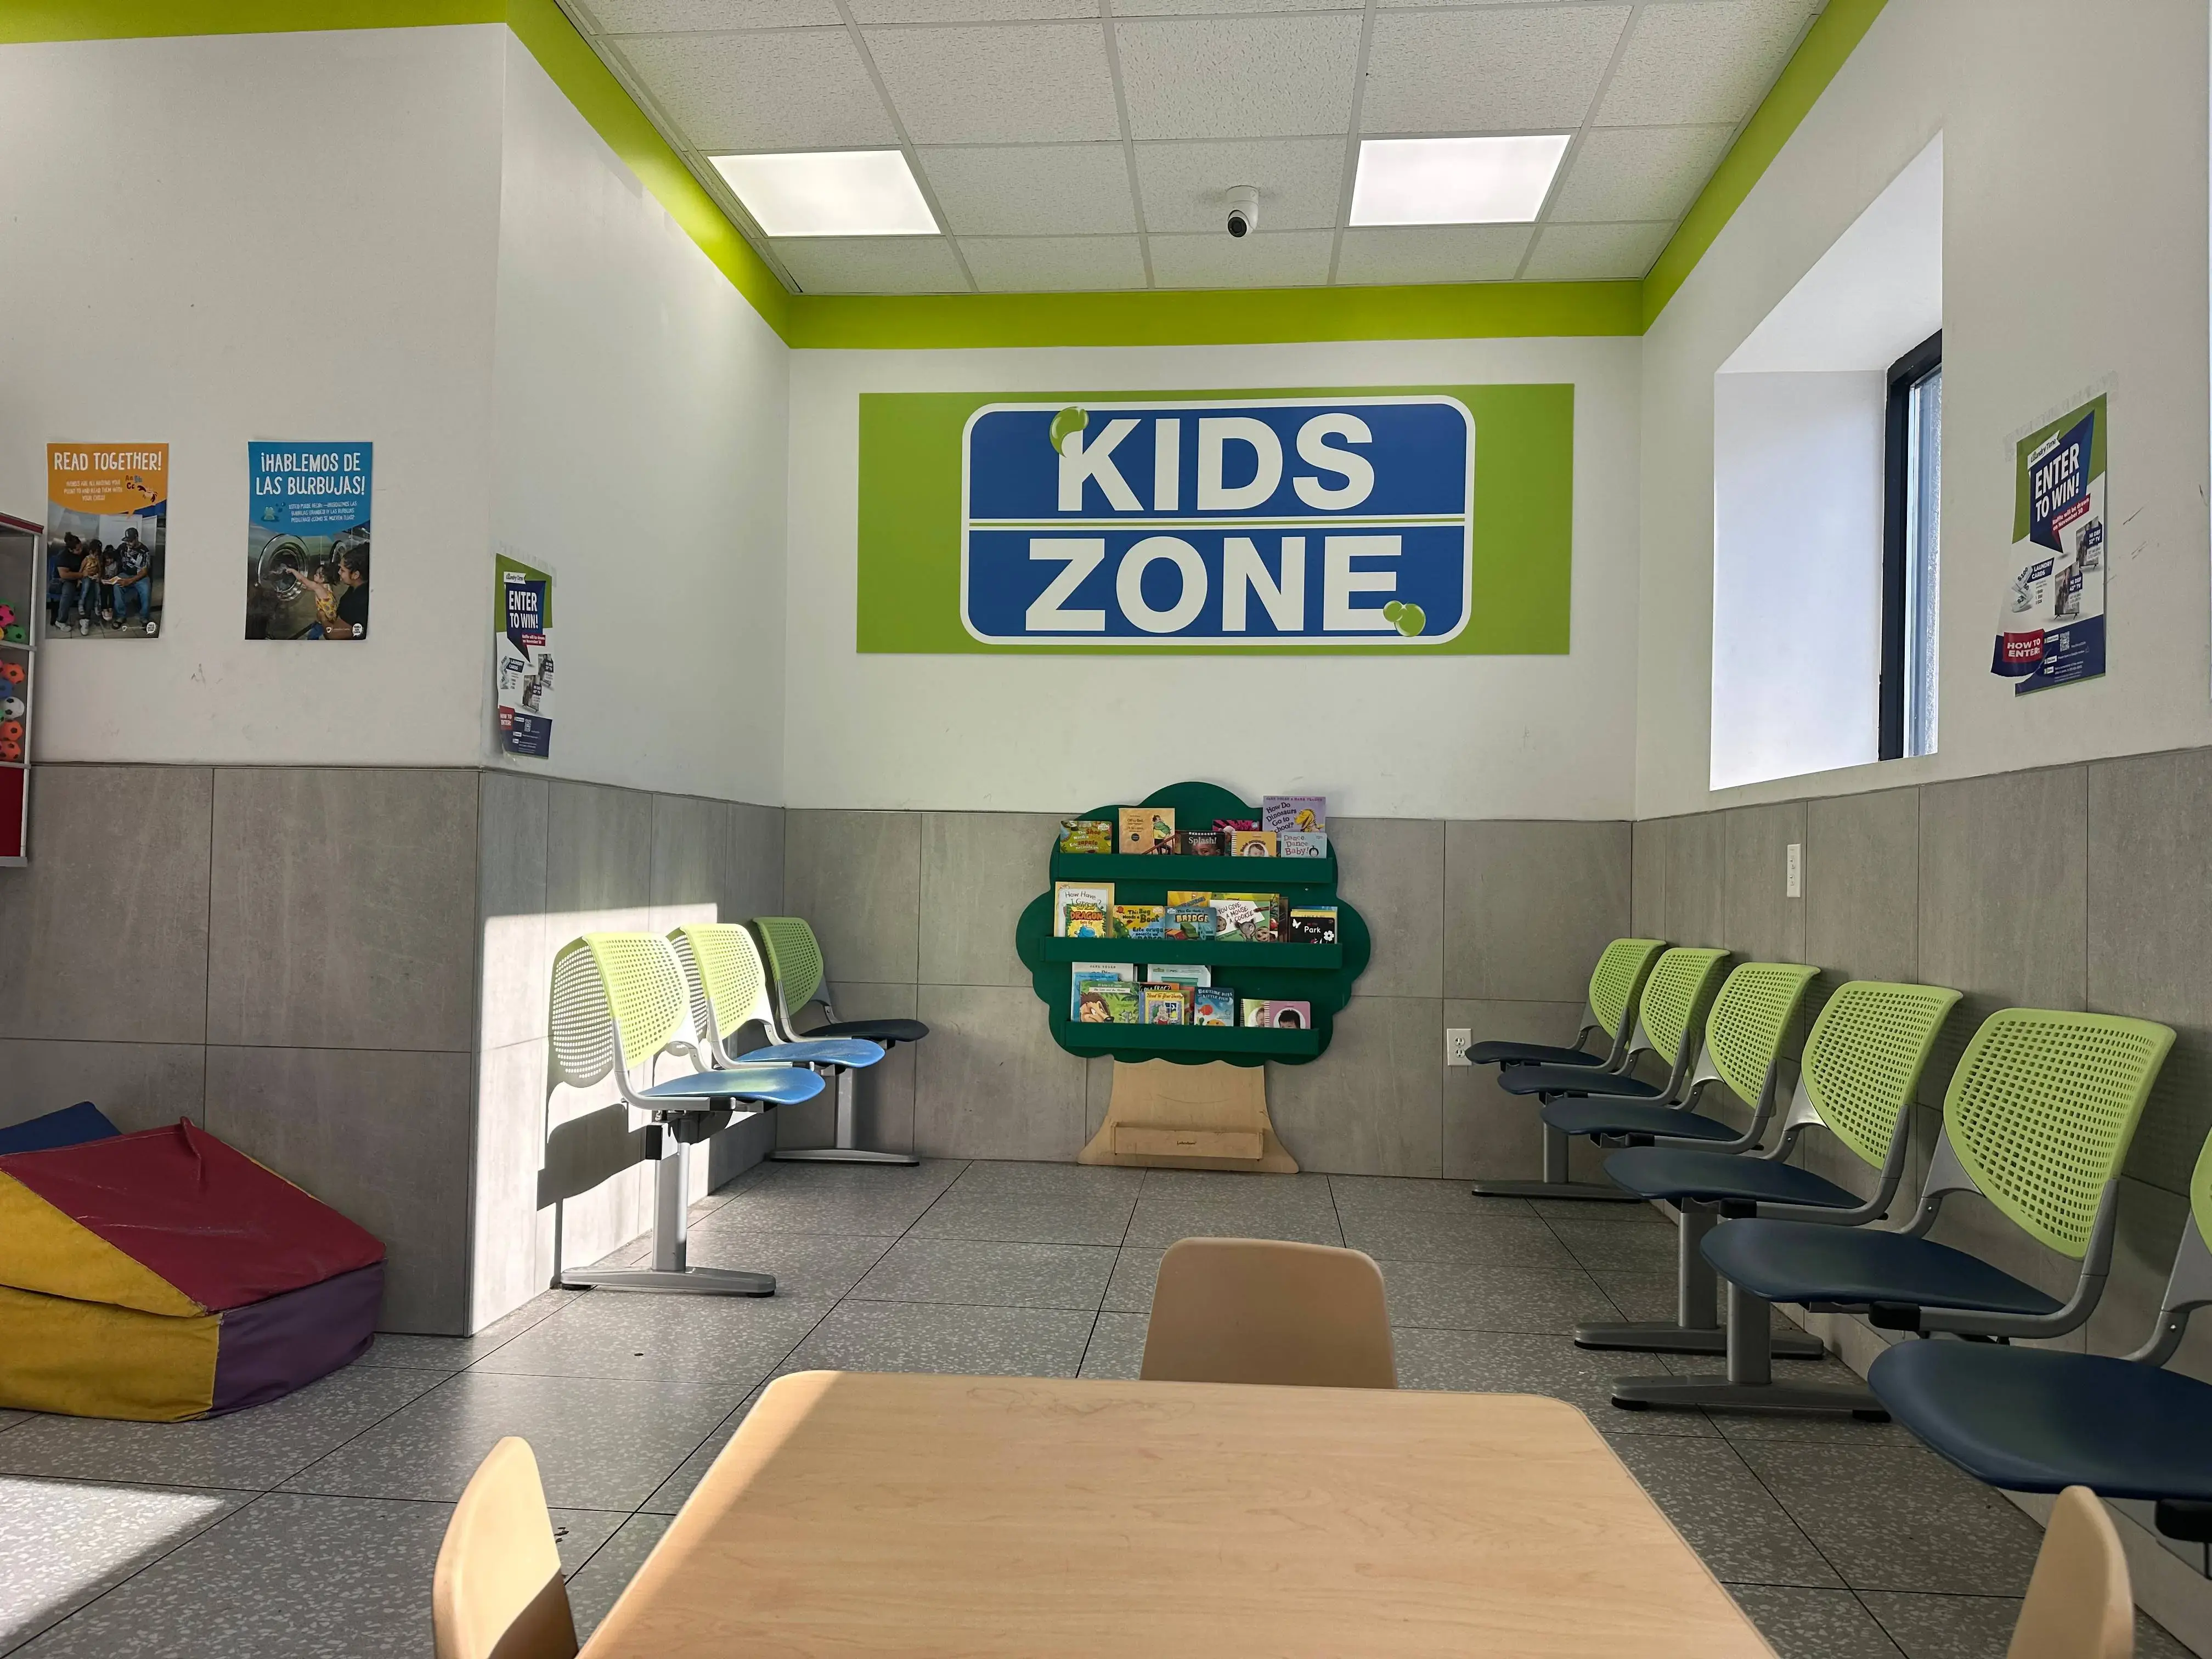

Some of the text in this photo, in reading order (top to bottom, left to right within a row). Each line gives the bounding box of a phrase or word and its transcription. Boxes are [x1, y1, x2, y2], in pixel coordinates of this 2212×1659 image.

[2046, 438, 2056, 450] Time
[54, 451, 162, 471] READ TOGETHER!
[261, 452, 361, 472] ¡HABLEMOS DE
[1057, 413, 1375, 512] KIDS
[2035, 443, 2080, 500] ENTER
[256, 476, 365, 495] LAS BURBUJAS!
[2035, 472, 2080, 522] TO WIN!
[2076, 498, 2090, 509] drawn
[2034, 560, 2052, 572] LAUNDRY
[2032, 570, 2045, 579] CARDS
[1025, 534, 1402, 633] ZONE
[509, 590, 538, 612] ENTER
[510, 612, 538, 629] TO WIN!
[2007, 641, 2032, 649] HOW
[2033, 638, 2041, 647] TO
[2008, 647, 2040, 657] ENTER:
[1266, 804, 1281, 814] How
[1266, 809, 1297, 822] Dinosaurs
[1270, 822, 1294, 833] chool?
[1188, 837, 1217, 845] Splash!
[1285, 847, 1310, 856] Baby!
[1081, 891, 1096, 900] Have
[1217, 901, 1242, 915] YOU GIVE
[1230, 906, 1249, 917] MOUSE
[1070, 911, 1103, 921] DRAGON
[1139, 914, 1160, 923] Boat
[1176, 914, 1209, 923] BRIDGE
[1234, 910, 1254, 922] COOKIE
